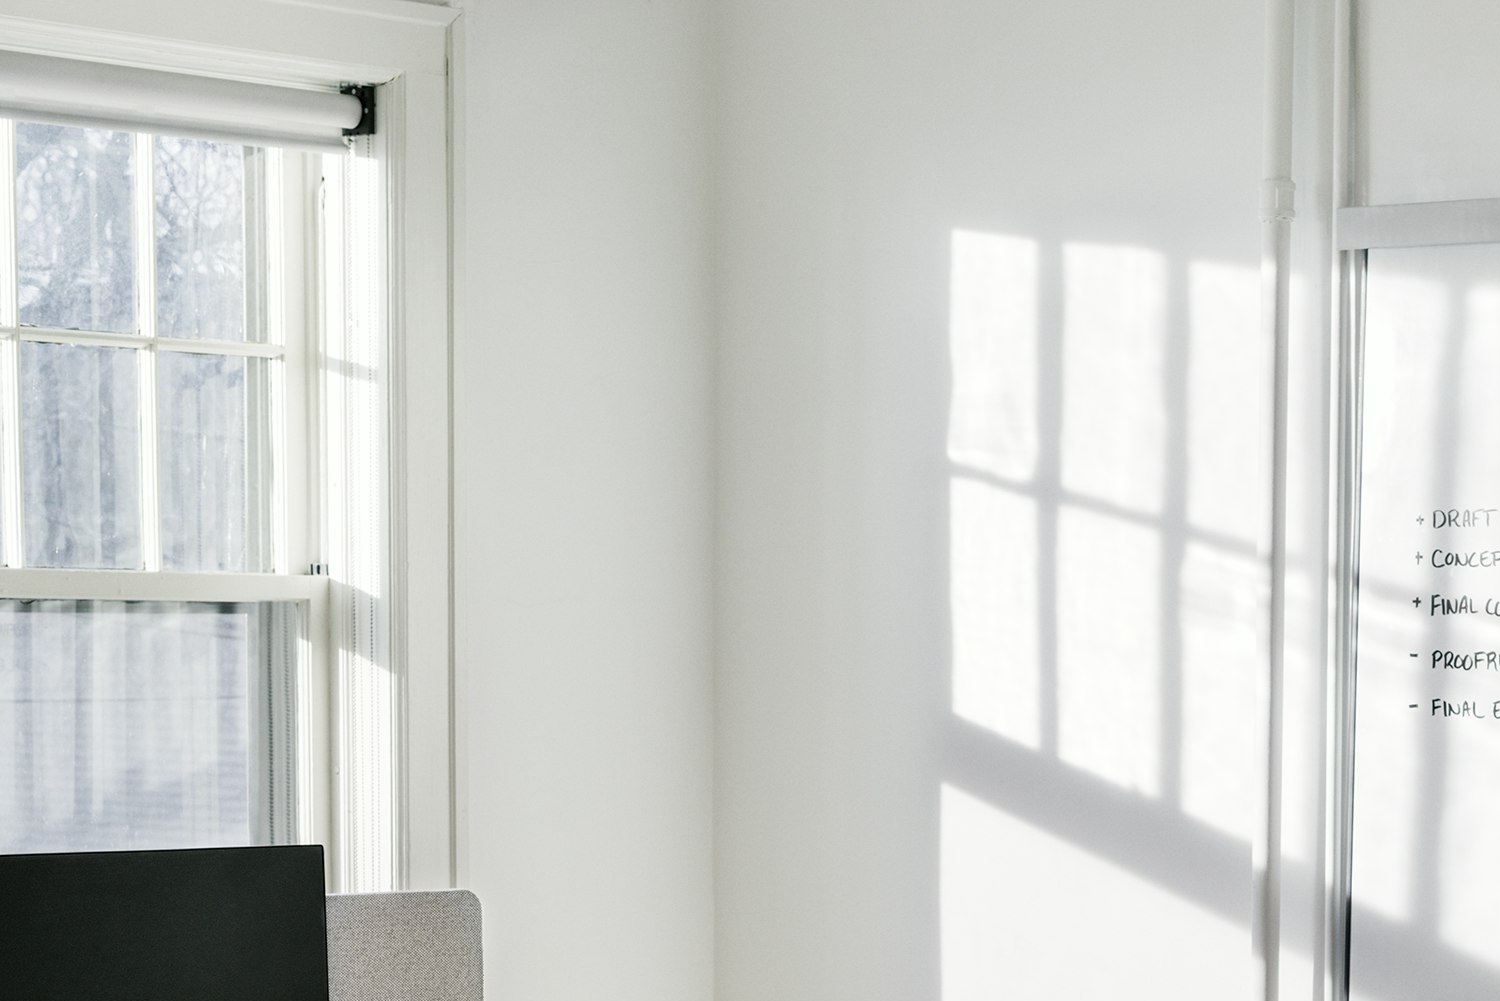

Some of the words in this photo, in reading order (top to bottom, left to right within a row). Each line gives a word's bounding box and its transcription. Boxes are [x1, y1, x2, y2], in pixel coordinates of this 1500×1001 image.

[1432, 508, 1498, 529] DRAFT
[1430, 593, 1479, 617] FINAL
[1431, 697, 1486, 720] FINAL
